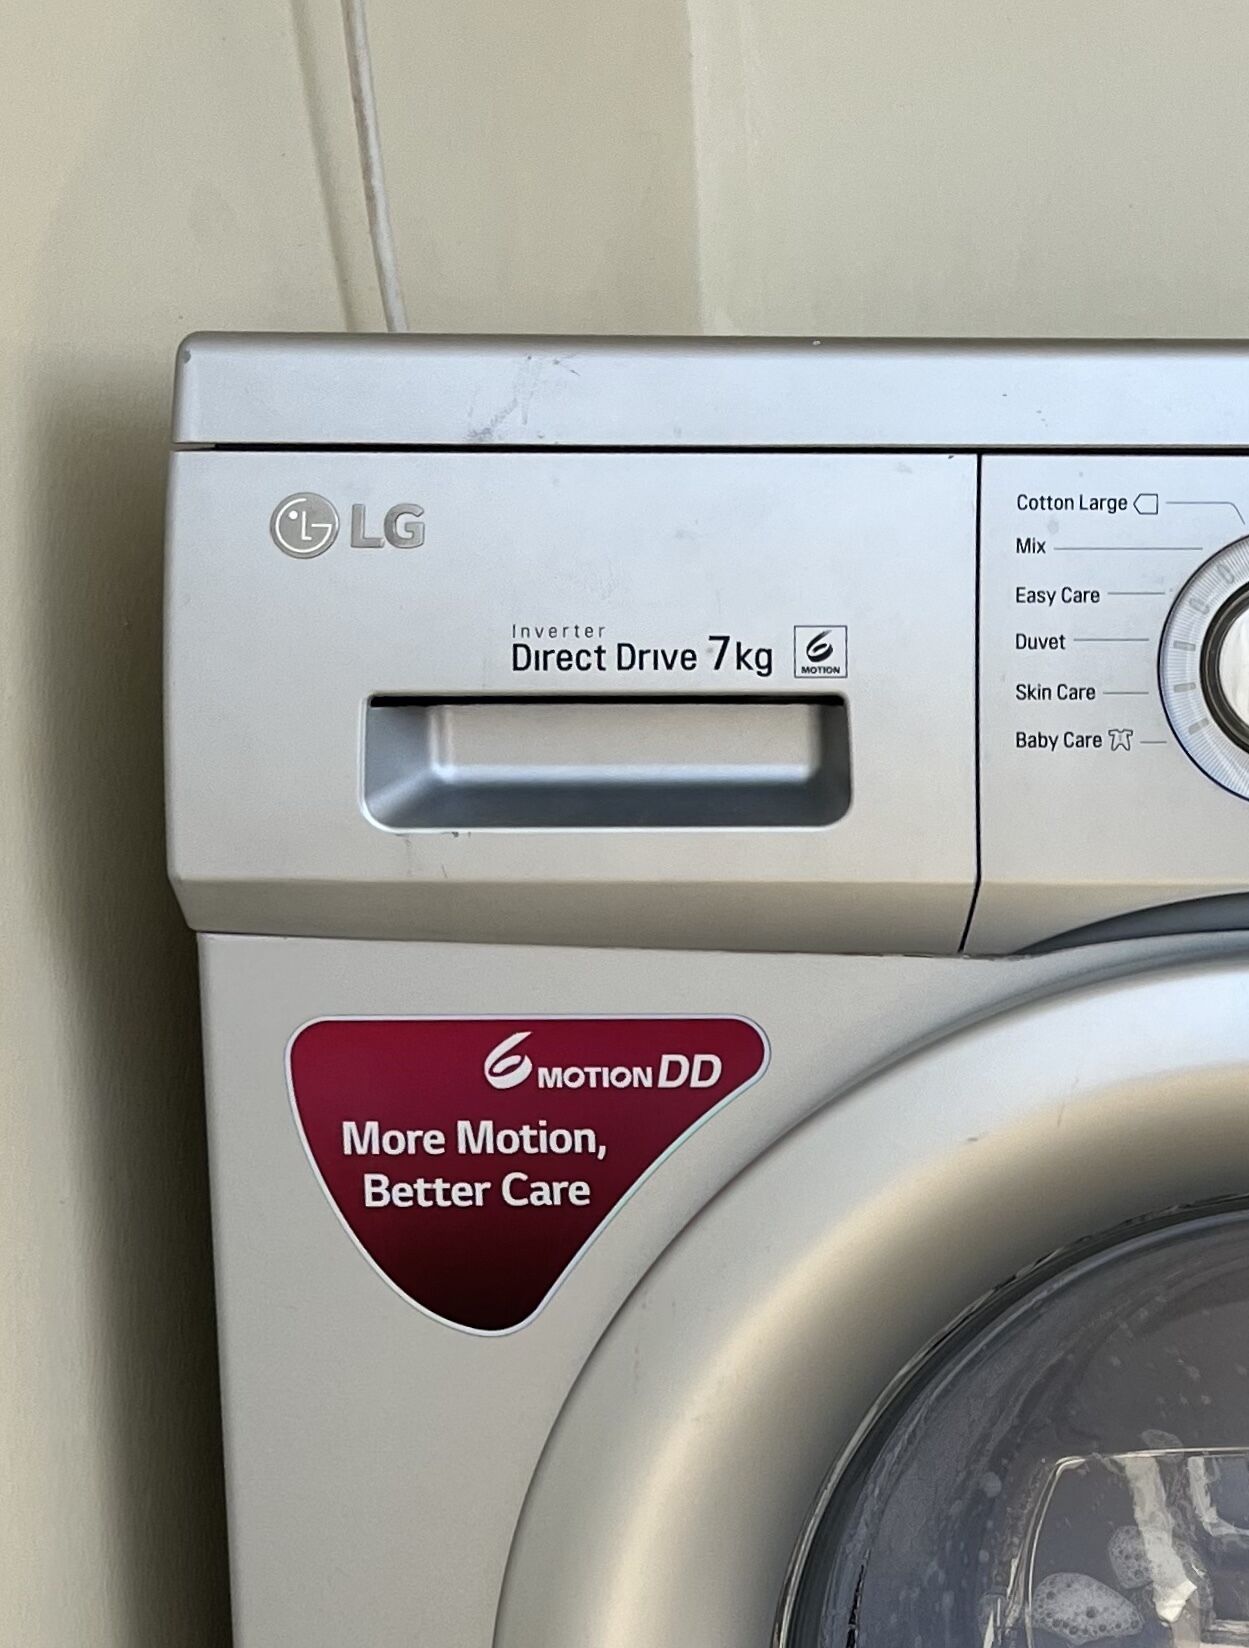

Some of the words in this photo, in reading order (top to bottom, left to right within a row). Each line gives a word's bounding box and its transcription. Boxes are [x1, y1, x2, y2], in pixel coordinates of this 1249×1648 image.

[1016, 494, 1075, 511] Cotton
[1080, 495, 1127, 514] Large
[350, 503, 425, 549] LG
[1016, 538, 1046, 554] Mix
[1016, 587, 1053, 606] Easy
[1061, 587, 1100, 603] Care
[512, 624, 606, 639] Inverter
[1015, 633, 1066, 650] Duvet
[513, 644, 606, 671] Direct
[617, 643, 697, 670] Drive
[800, 666, 841, 675] MOTION
[1015, 684, 1052, 701] Skin
[1056, 684, 1096, 701] Care
[1016, 732, 1058, 751] Baby
[1063, 732, 1103, 749] Care
[538, 1067, 652, 1088] MOTION
[658, 1054, 721, 1087] DD
[343, 1121, 445, 1154] More
[457, 1120, 606, 1159] Motion,
[364, 1174, 491, 1207] Better
[502, 1172, 590, 1206] Care
